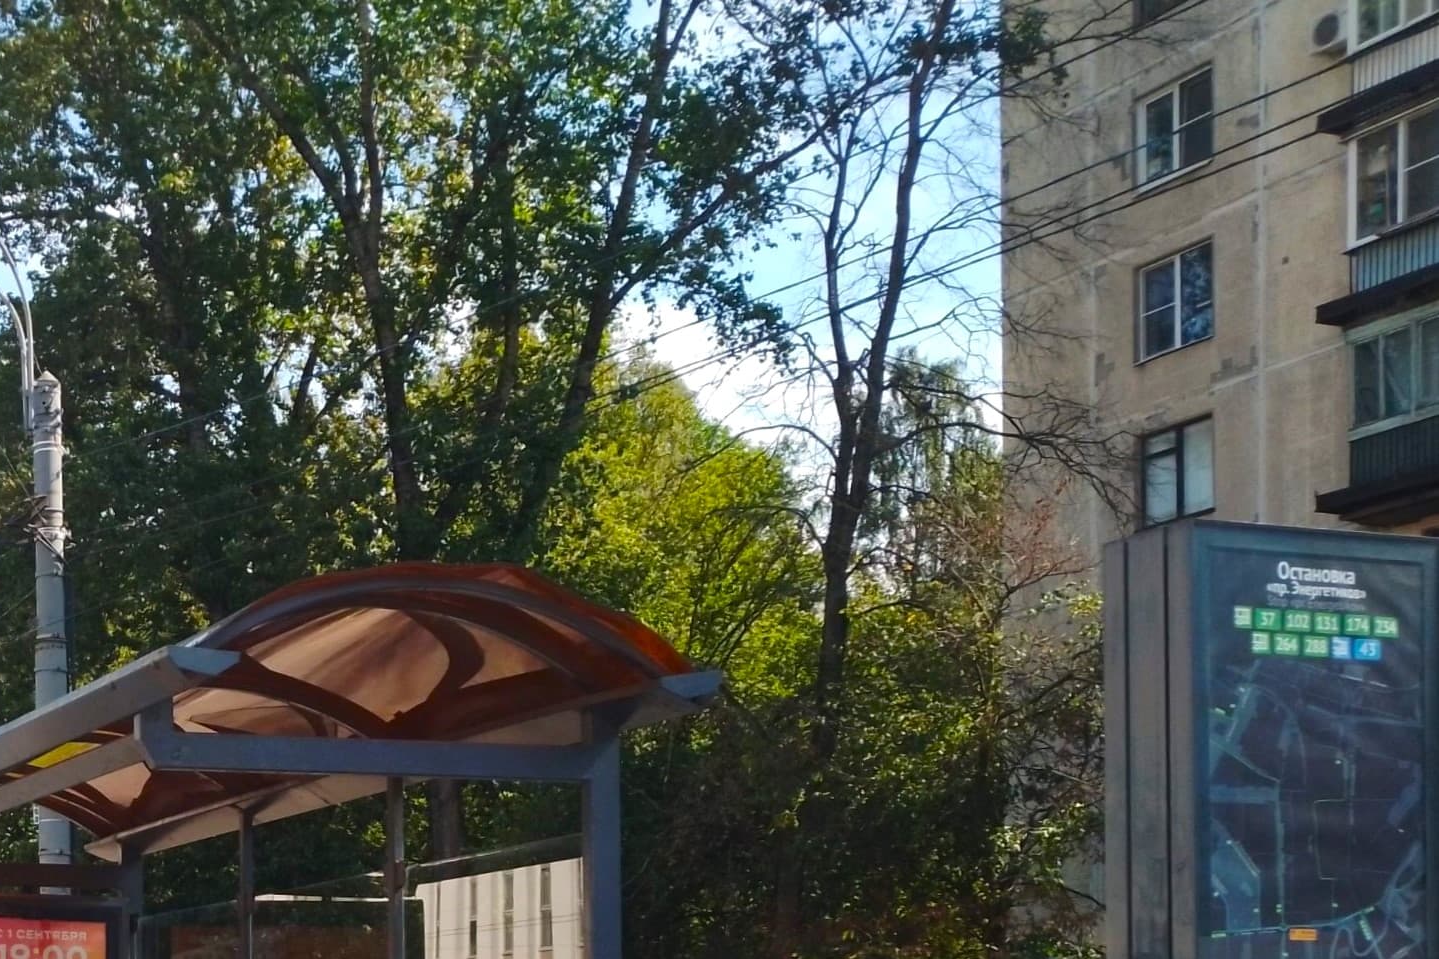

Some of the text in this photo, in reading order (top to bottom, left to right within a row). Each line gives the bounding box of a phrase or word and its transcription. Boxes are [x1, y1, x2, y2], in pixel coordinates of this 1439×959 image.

[1277, 561, 1356, 585] Остановка
[1259, 612, 1275, 626] 37
[1286, 614, 1310, 629] 102
[1346, 618, 1370, 633] 174
[1275, 634, 1298, 651] 264
[1359, 642, 1376, 657] 43
[16, 929, 87, 941] СЕНТЯБРЯ
